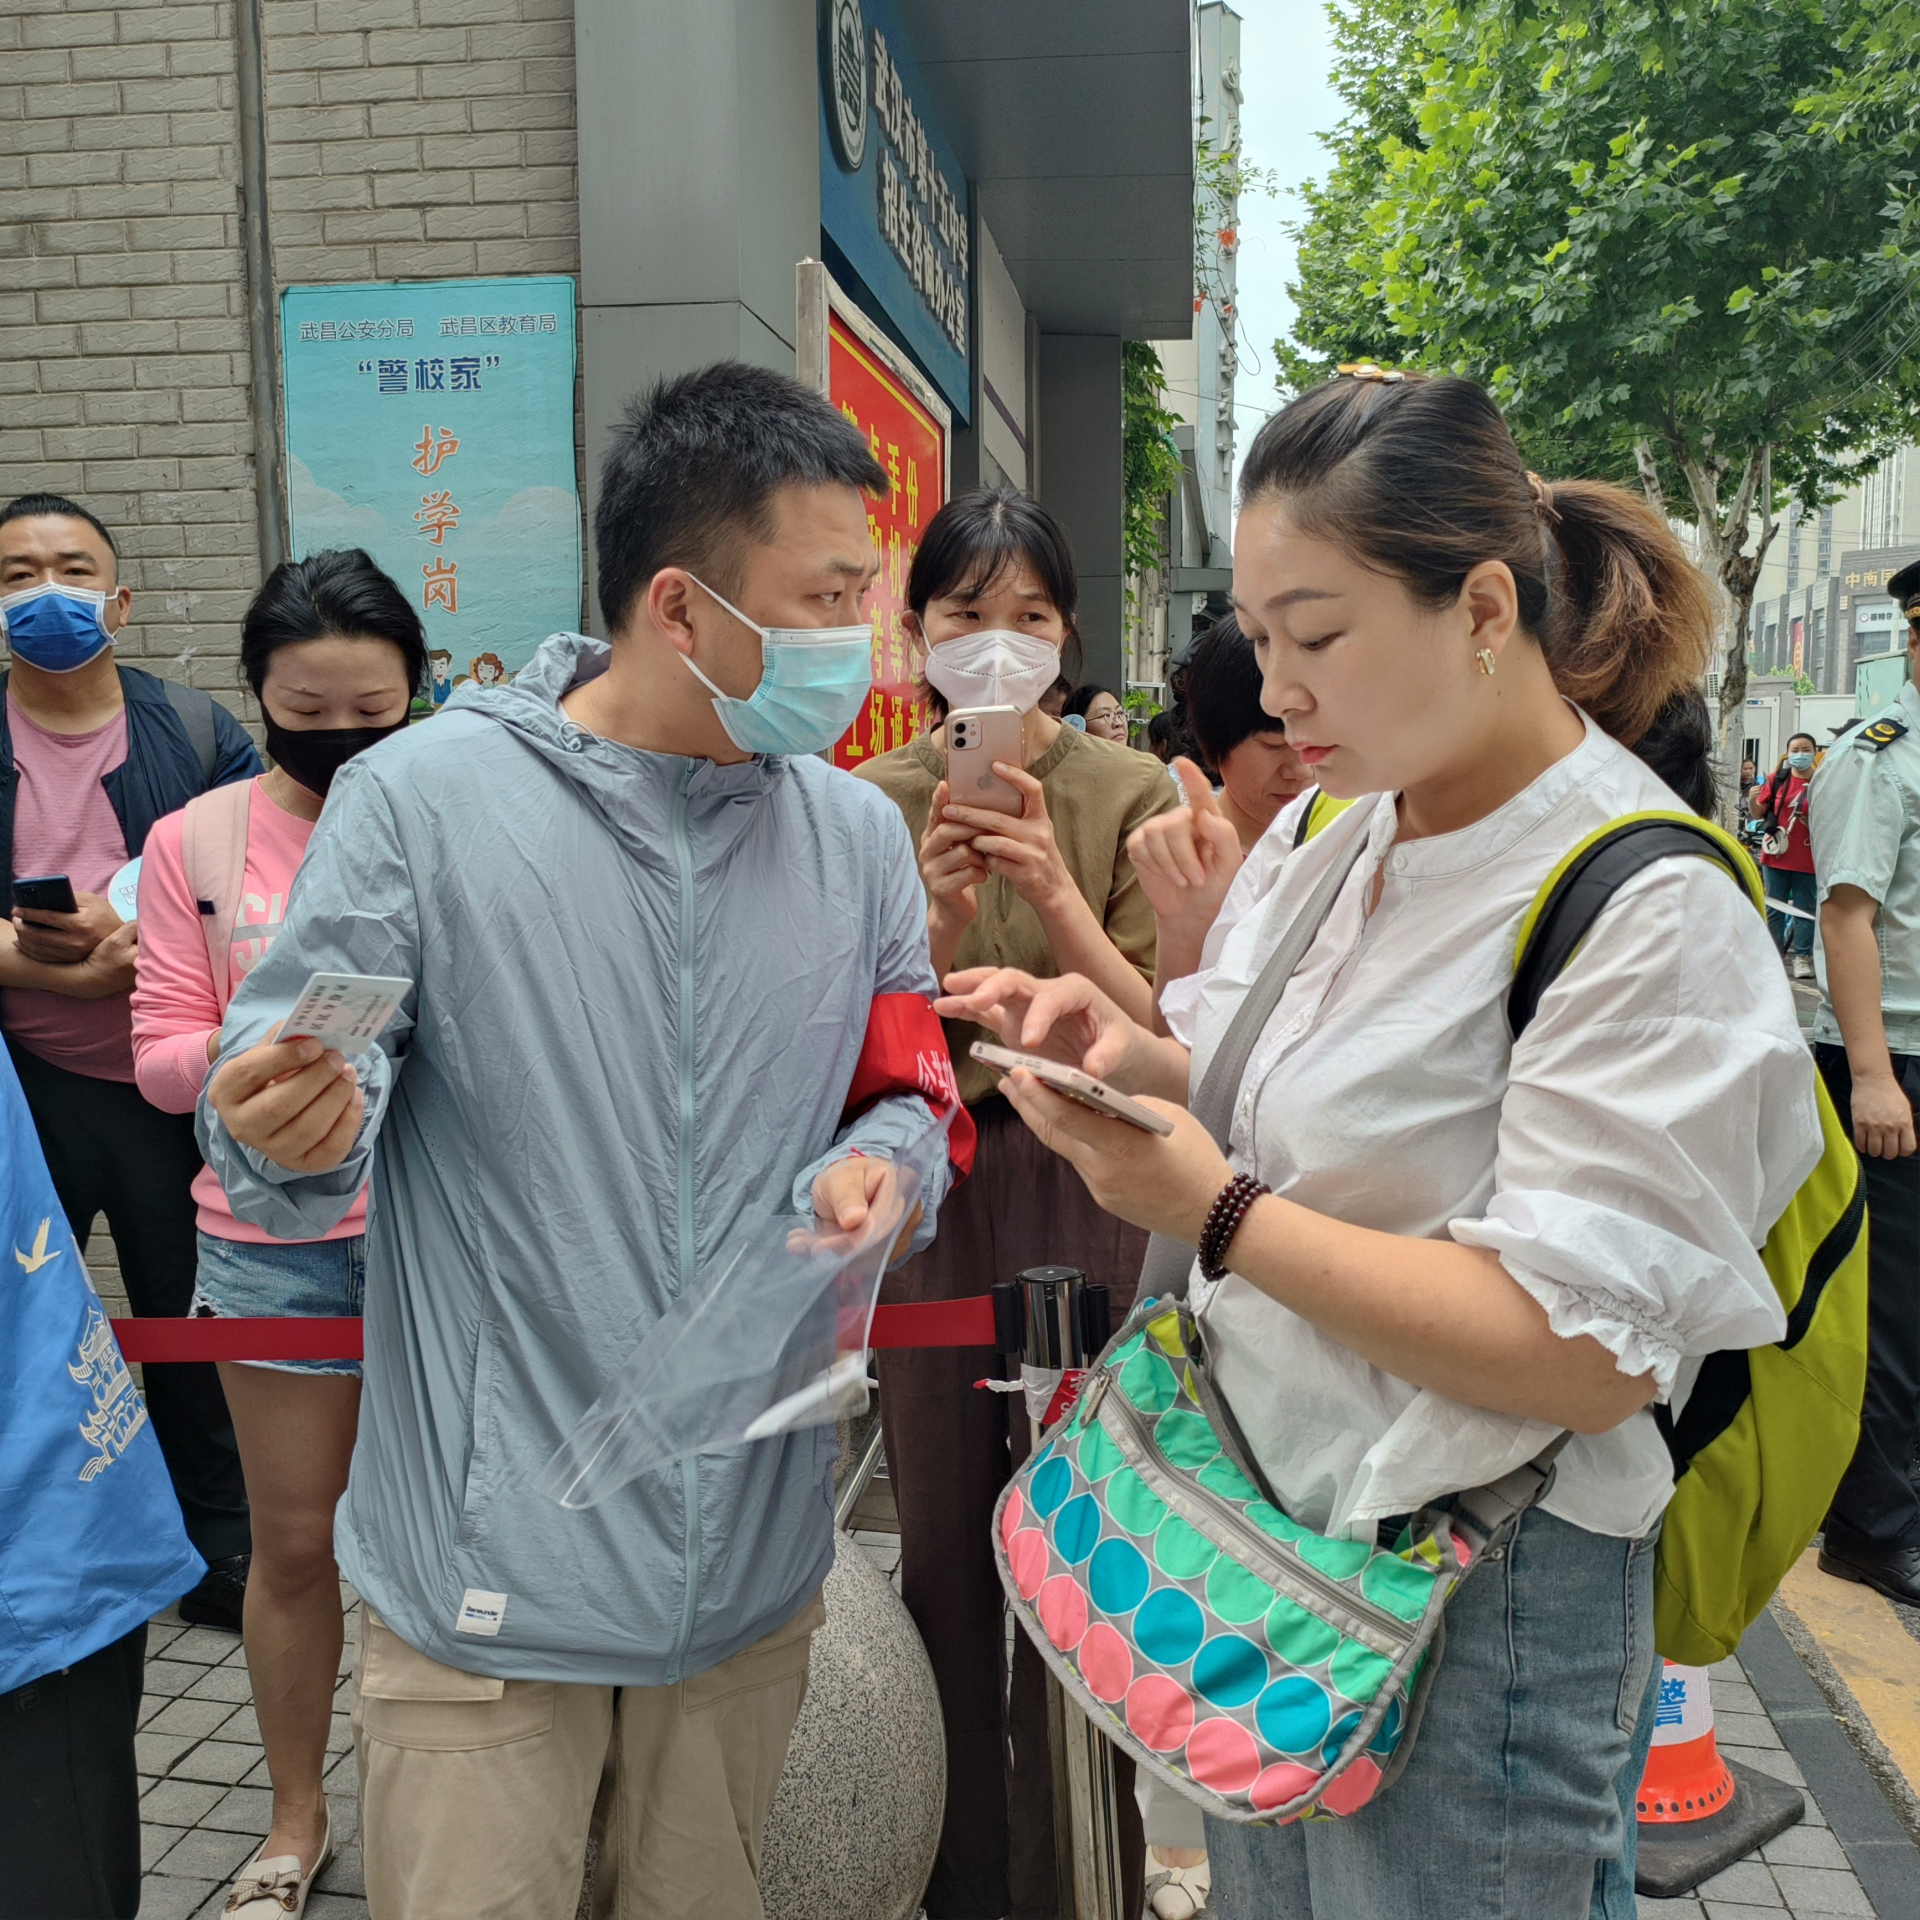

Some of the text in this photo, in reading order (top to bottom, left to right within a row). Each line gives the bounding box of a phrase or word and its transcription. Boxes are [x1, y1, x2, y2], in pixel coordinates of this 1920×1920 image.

[871, 27, 969, 282] 武汉市第十五中学
[879, 147, 966, 358] 招生咨询办公室
[299, 313, 557, 342] 武昌公安分局 武昌区教育局
[410, 424, 462, 615] 护学岗
